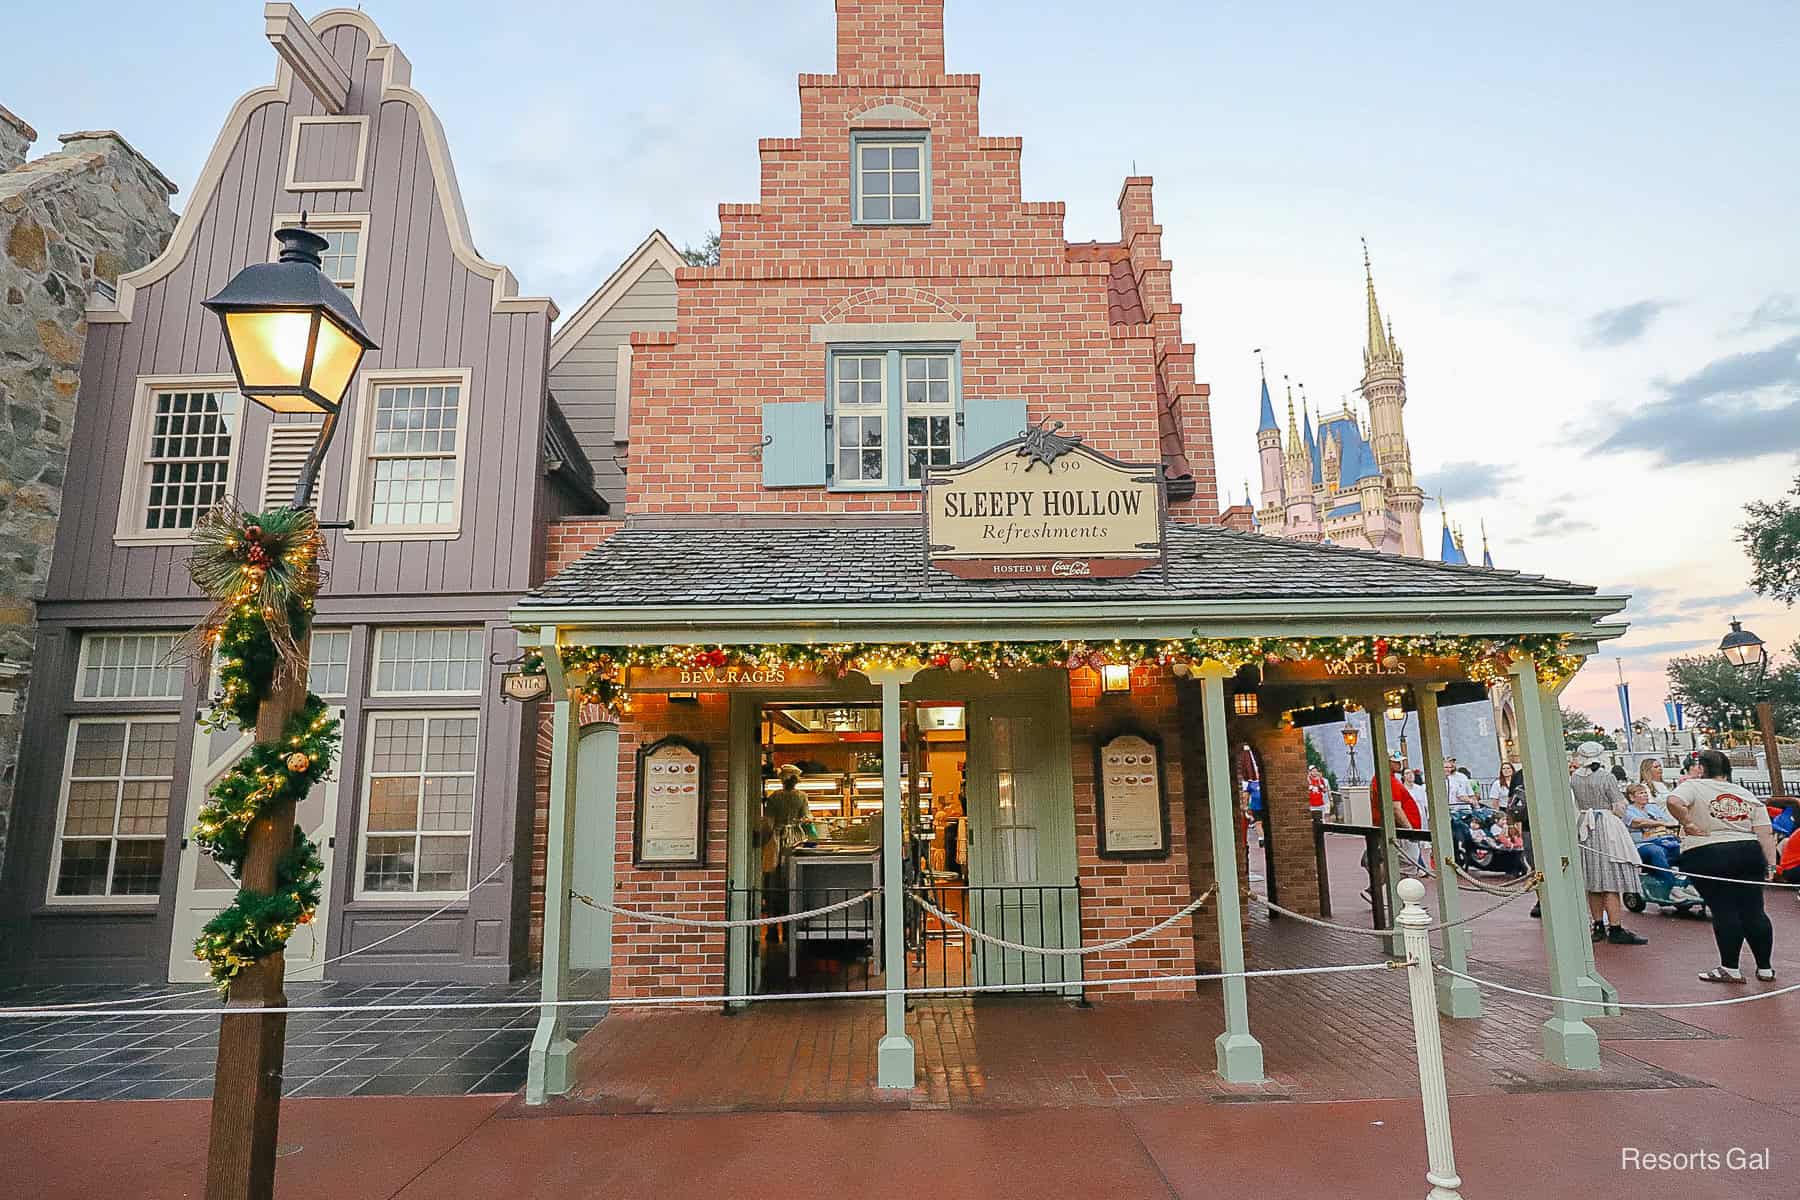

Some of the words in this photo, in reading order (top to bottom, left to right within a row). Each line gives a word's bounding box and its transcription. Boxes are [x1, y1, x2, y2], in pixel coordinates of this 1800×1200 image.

[1004, 462, 1018, 473] 17
[1060, 461, 1081, 472] 90
[945, 491, 1034, 518] SLEEPY
[1042, 490, 1142, 516] HOLLOW
[983, 522, 1108, 544] Refreshments
[993, 565, 1033, 573] HOSTED
[1035, 564, 1047, 573] BY
